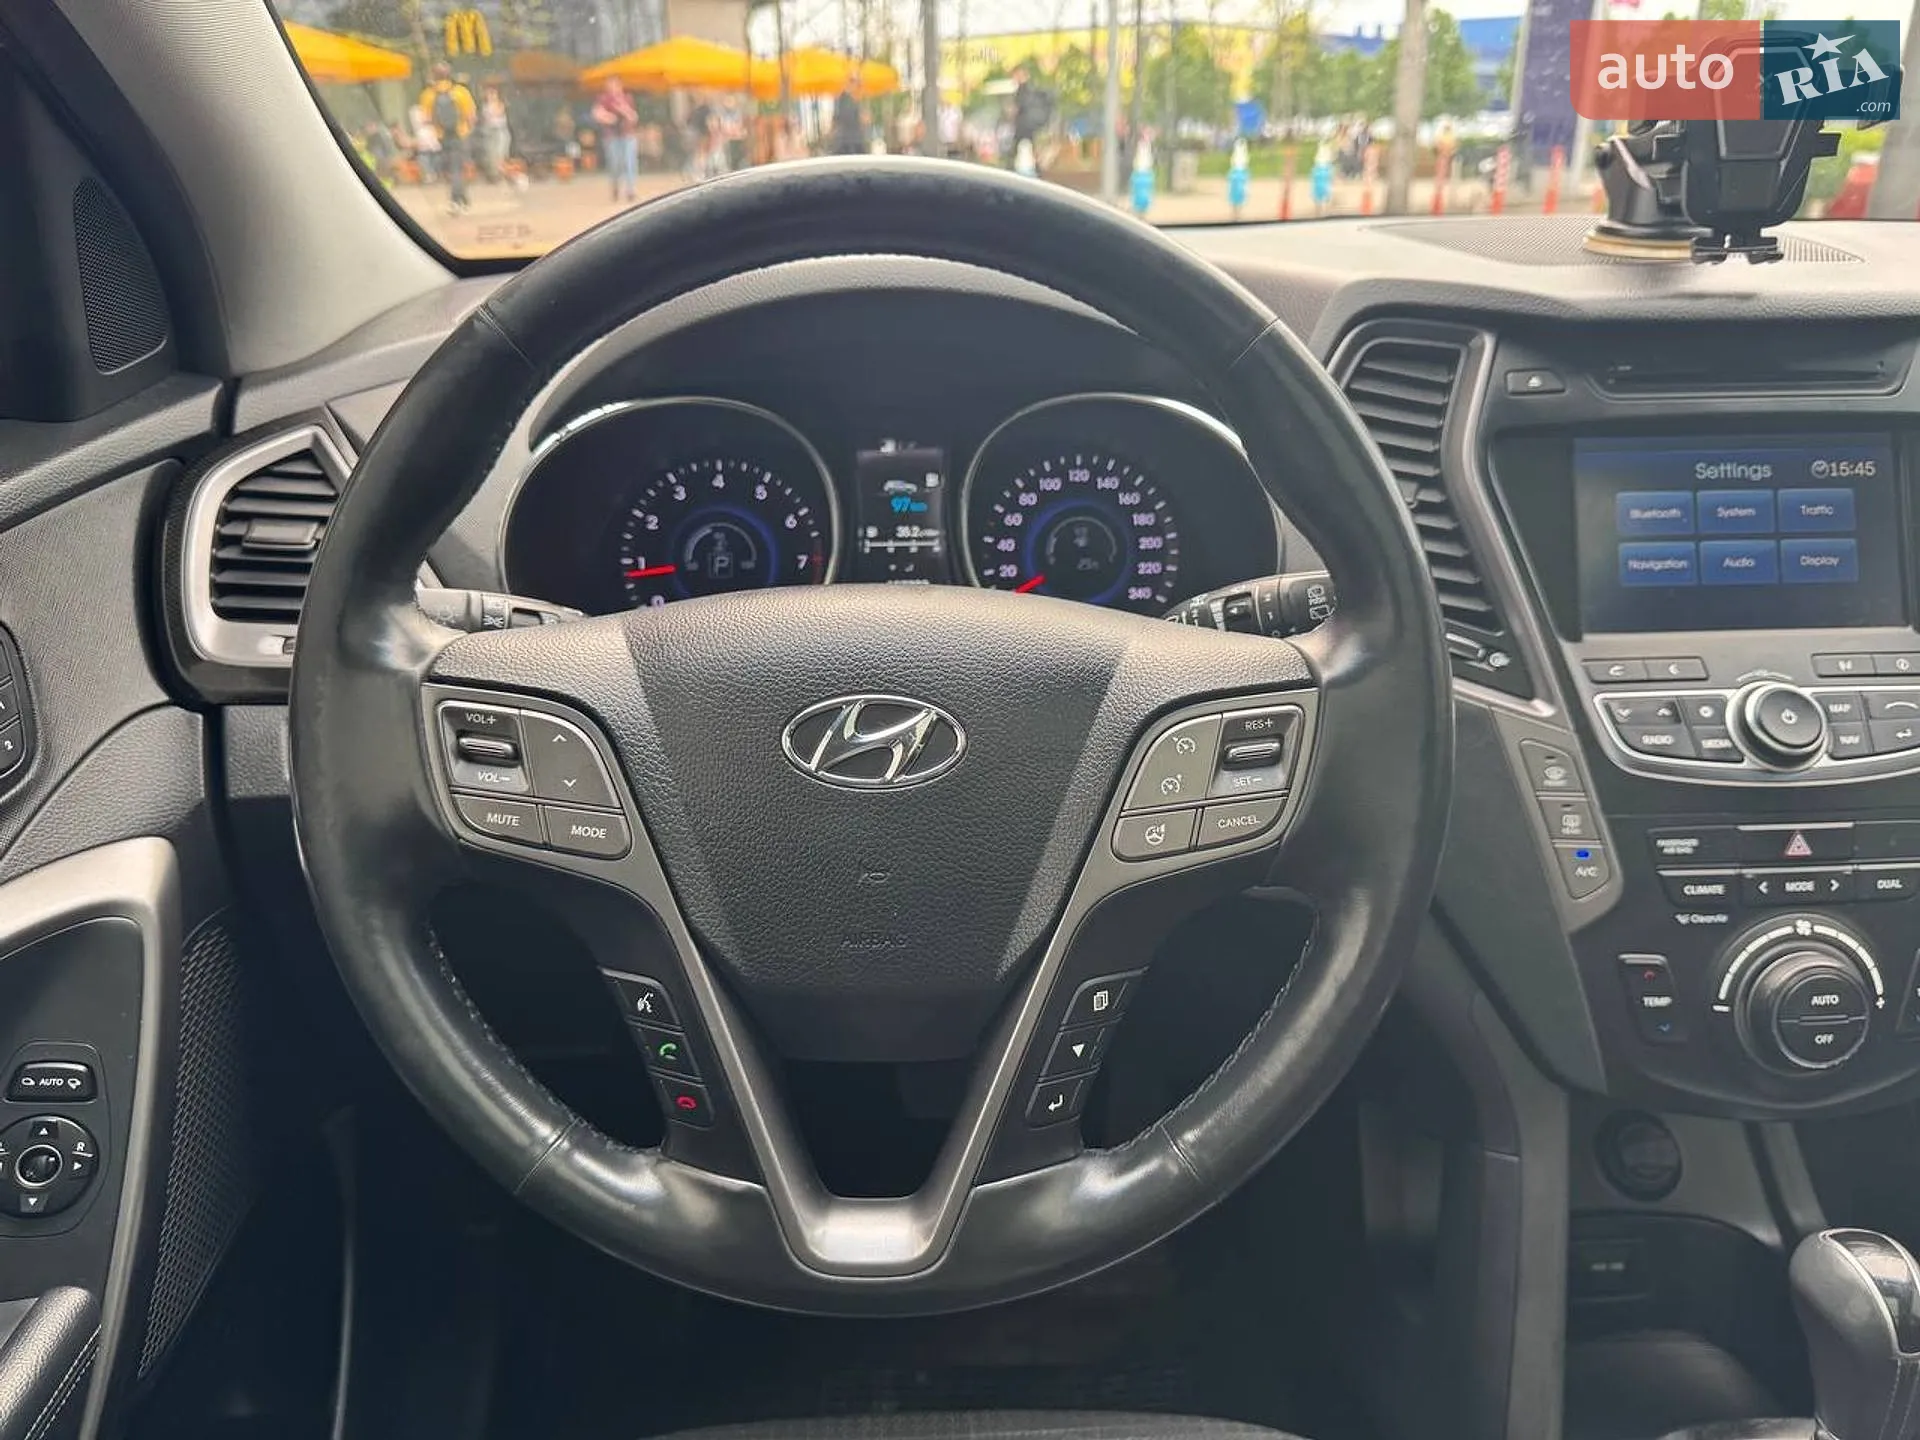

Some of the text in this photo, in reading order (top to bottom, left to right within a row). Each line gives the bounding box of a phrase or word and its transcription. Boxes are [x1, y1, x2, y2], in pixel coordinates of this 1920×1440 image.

[1068, 468, 1090, 482] 120
[1695, 462, 1772, 481] Settings
[711, 473, 725, 489] 4
[1039, 477, 1062, 491] 100
[1096, 476, 1120, 490] 140
[673, 484, 687, 501] 3
[1018, 492, 1038, 506] 80
[1118, 492, 1141, 506] 160
[1629, 507, 1681, 519] Bluetooth
[1716, 506, 1756, 519] System
[1800, 504, 1834, 516] Traffic
[646, 514, 659, 530] 2
[784, 513, 798, 529] 6
[1003, 512, 1023, 527] 60
[1132, 513, 1155, 527] 180
[996, 538, 1016, 552] 40
[1138, 536, 1163, 550] 200
[715, 556, 729, 575] P
[797, 554, 809, 570] 7
[1137, 561, 1162, 575] 220
[1628, 558, 1688, 571] Navigation
[1723, 556, 1755, 568] Audio
[1800, 555, 1840, 567] Display
[998, 564, 1018, 578] 20
[1127, 586, 1152, 601] 240
[465, 712, 497, 725] VOL+
[1642, 734, 1674, 745] RADIO
[487, 812, 521, 827] MUTE
[1216, 815, 1261, 829] CANCEL
[571, 825, 608, 839] MODE
[1575, 866, 1599, 877] A/C
[1683, 884, 1725, 895] CLIMATE
[1785, 881, 1815, 893] MODE
[1877, 878, 1903, 890] DUAL
[1643, 996, 1673, 1007] TEMP
[1811, 994, 1840, 1006] AUTO
[1815, 1034, 1835, 1045] OFF
[39, 1078, 65, 1087] AUTO
[76, 1141, 86, 1151] R
